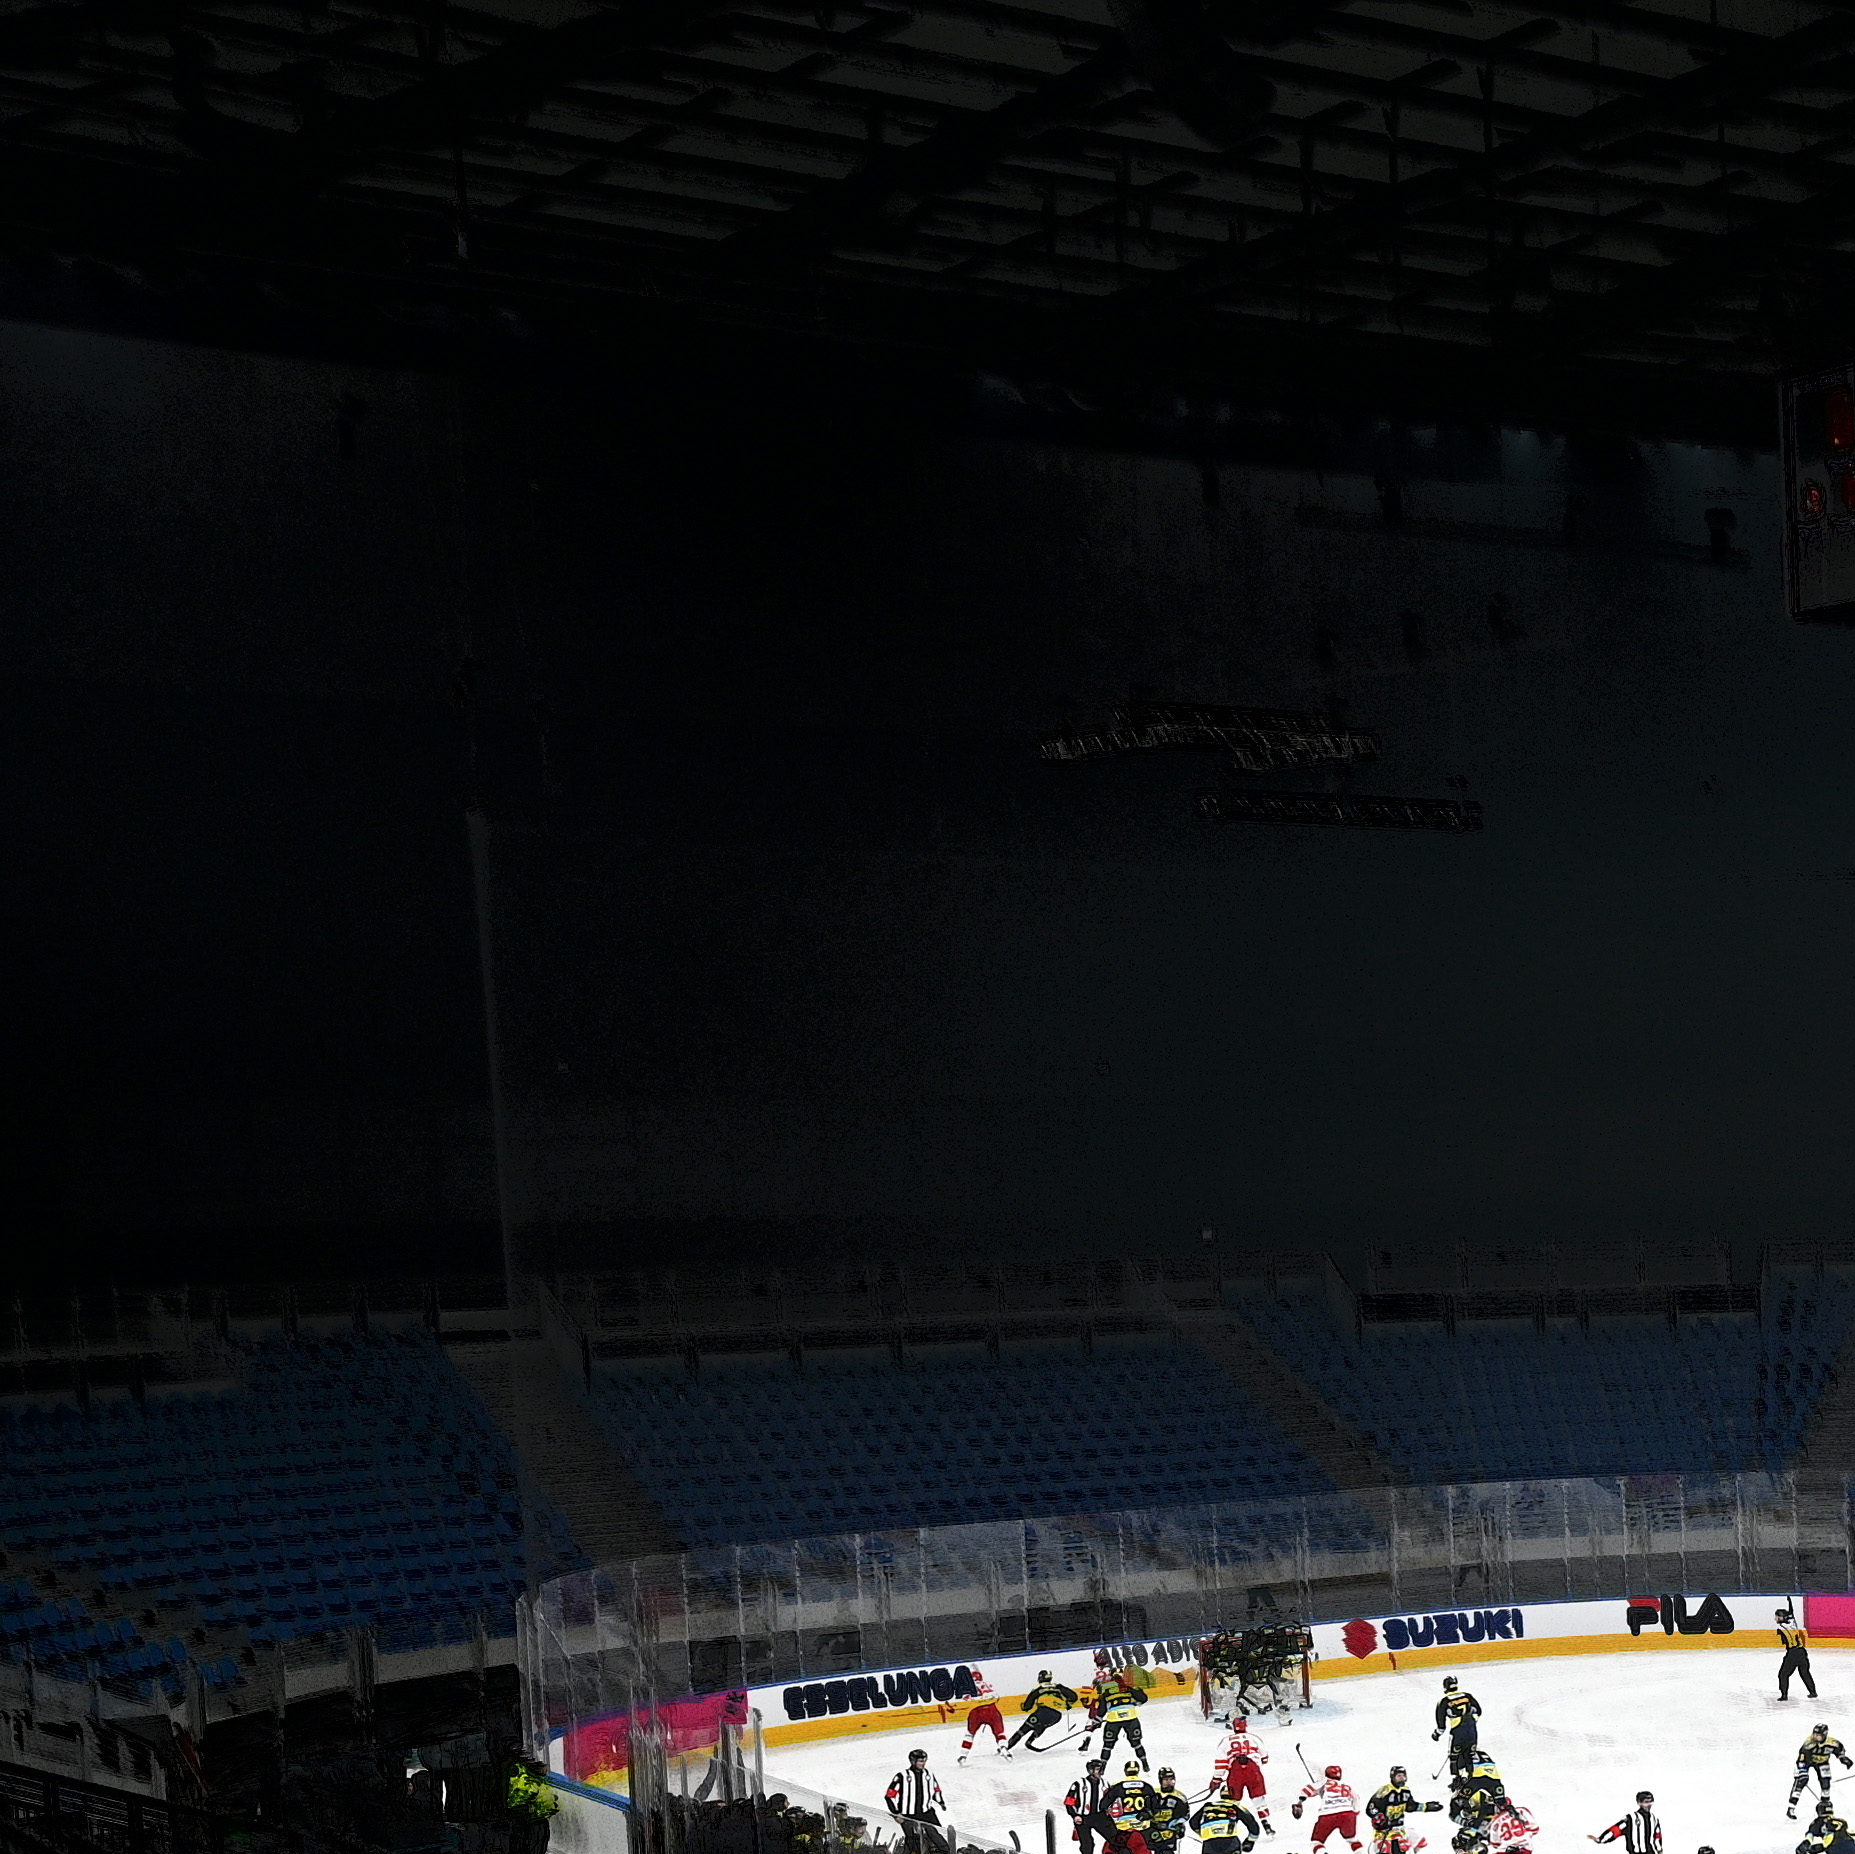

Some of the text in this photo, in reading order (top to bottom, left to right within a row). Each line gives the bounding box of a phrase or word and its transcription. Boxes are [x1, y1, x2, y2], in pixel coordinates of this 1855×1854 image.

[1382, 1608, 1523, 1650] SUZUKI
[1626, 1594, 1734, 1635] FILA
[1124, 1797, 1145, 1813] 20
